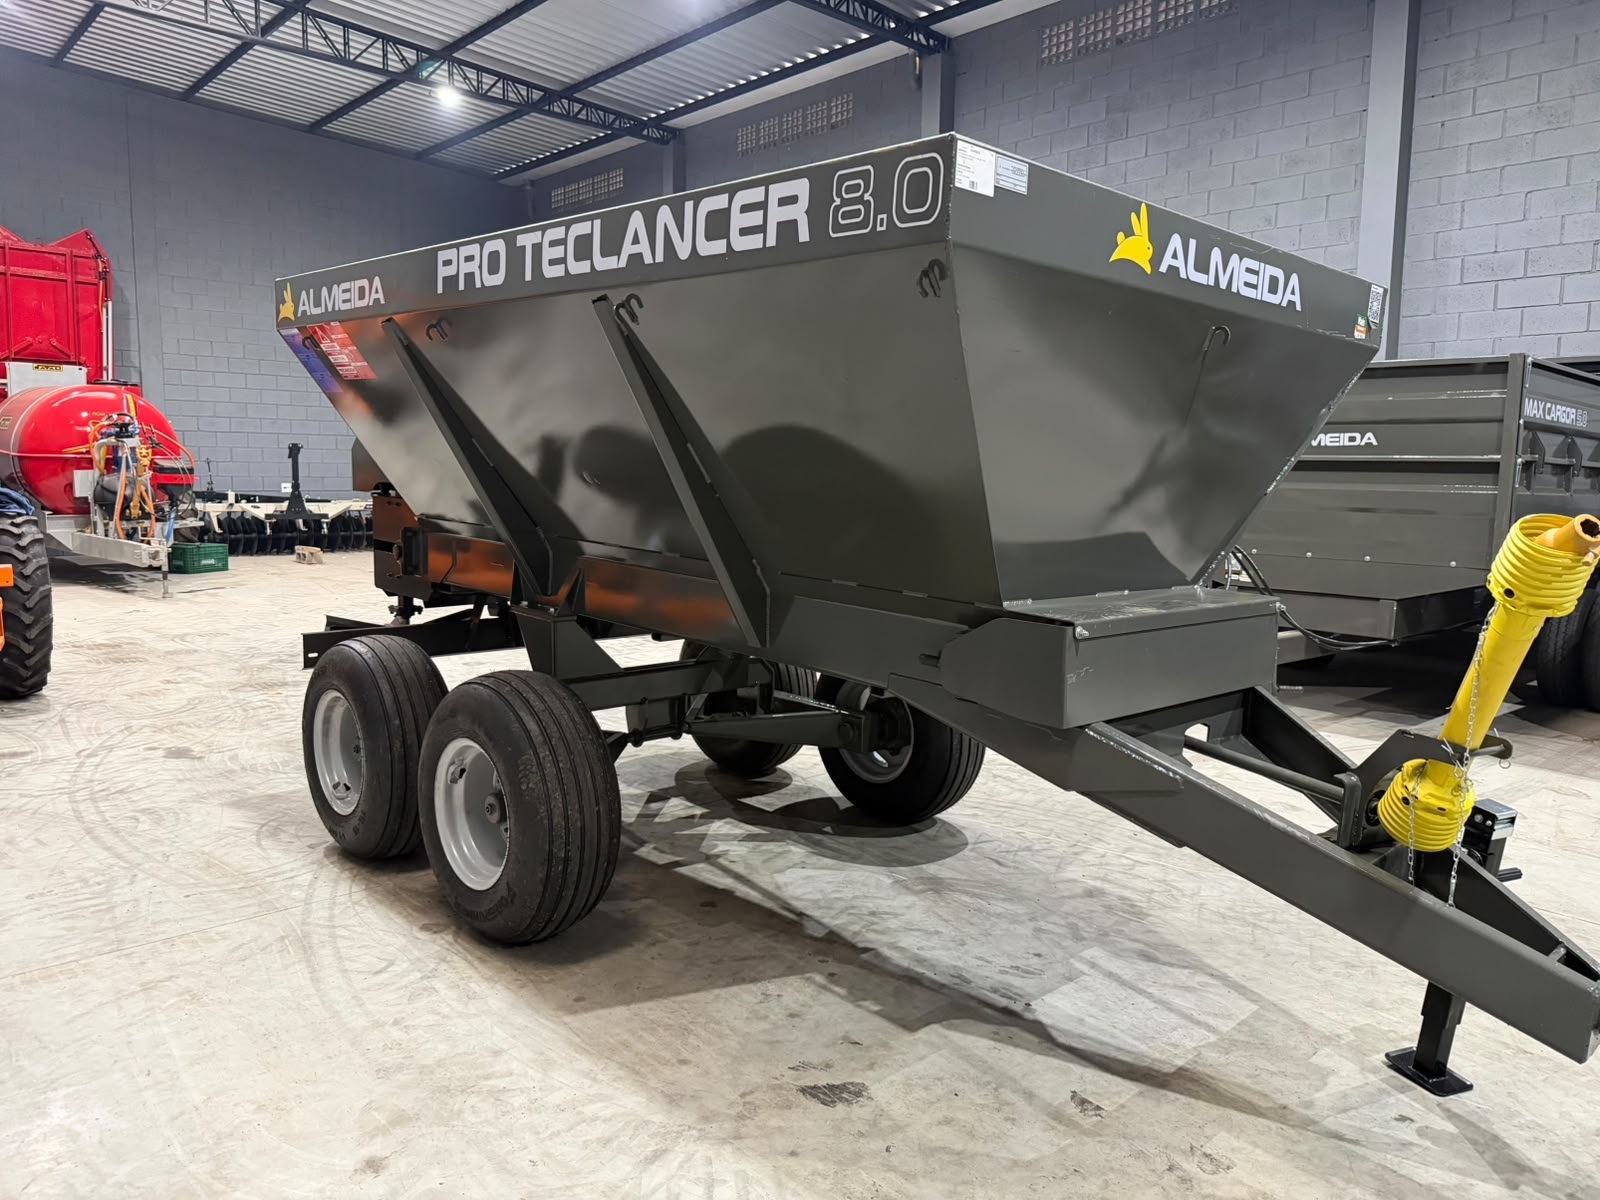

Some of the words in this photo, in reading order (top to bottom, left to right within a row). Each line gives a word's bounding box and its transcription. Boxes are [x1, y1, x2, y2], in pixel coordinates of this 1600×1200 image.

[437, 238, 506, 294] PRO
[516, 177, 810, 282] TECLANCER
[829, 152, 944, 238] 8.0
[297, 275, 386, 317] ALMEIDA
[1158, 232, 1302, 312] ALMEIDA
[1524, 397, 1545, 419] MAX
[1545, 402, 1577, 425] CARGOR
